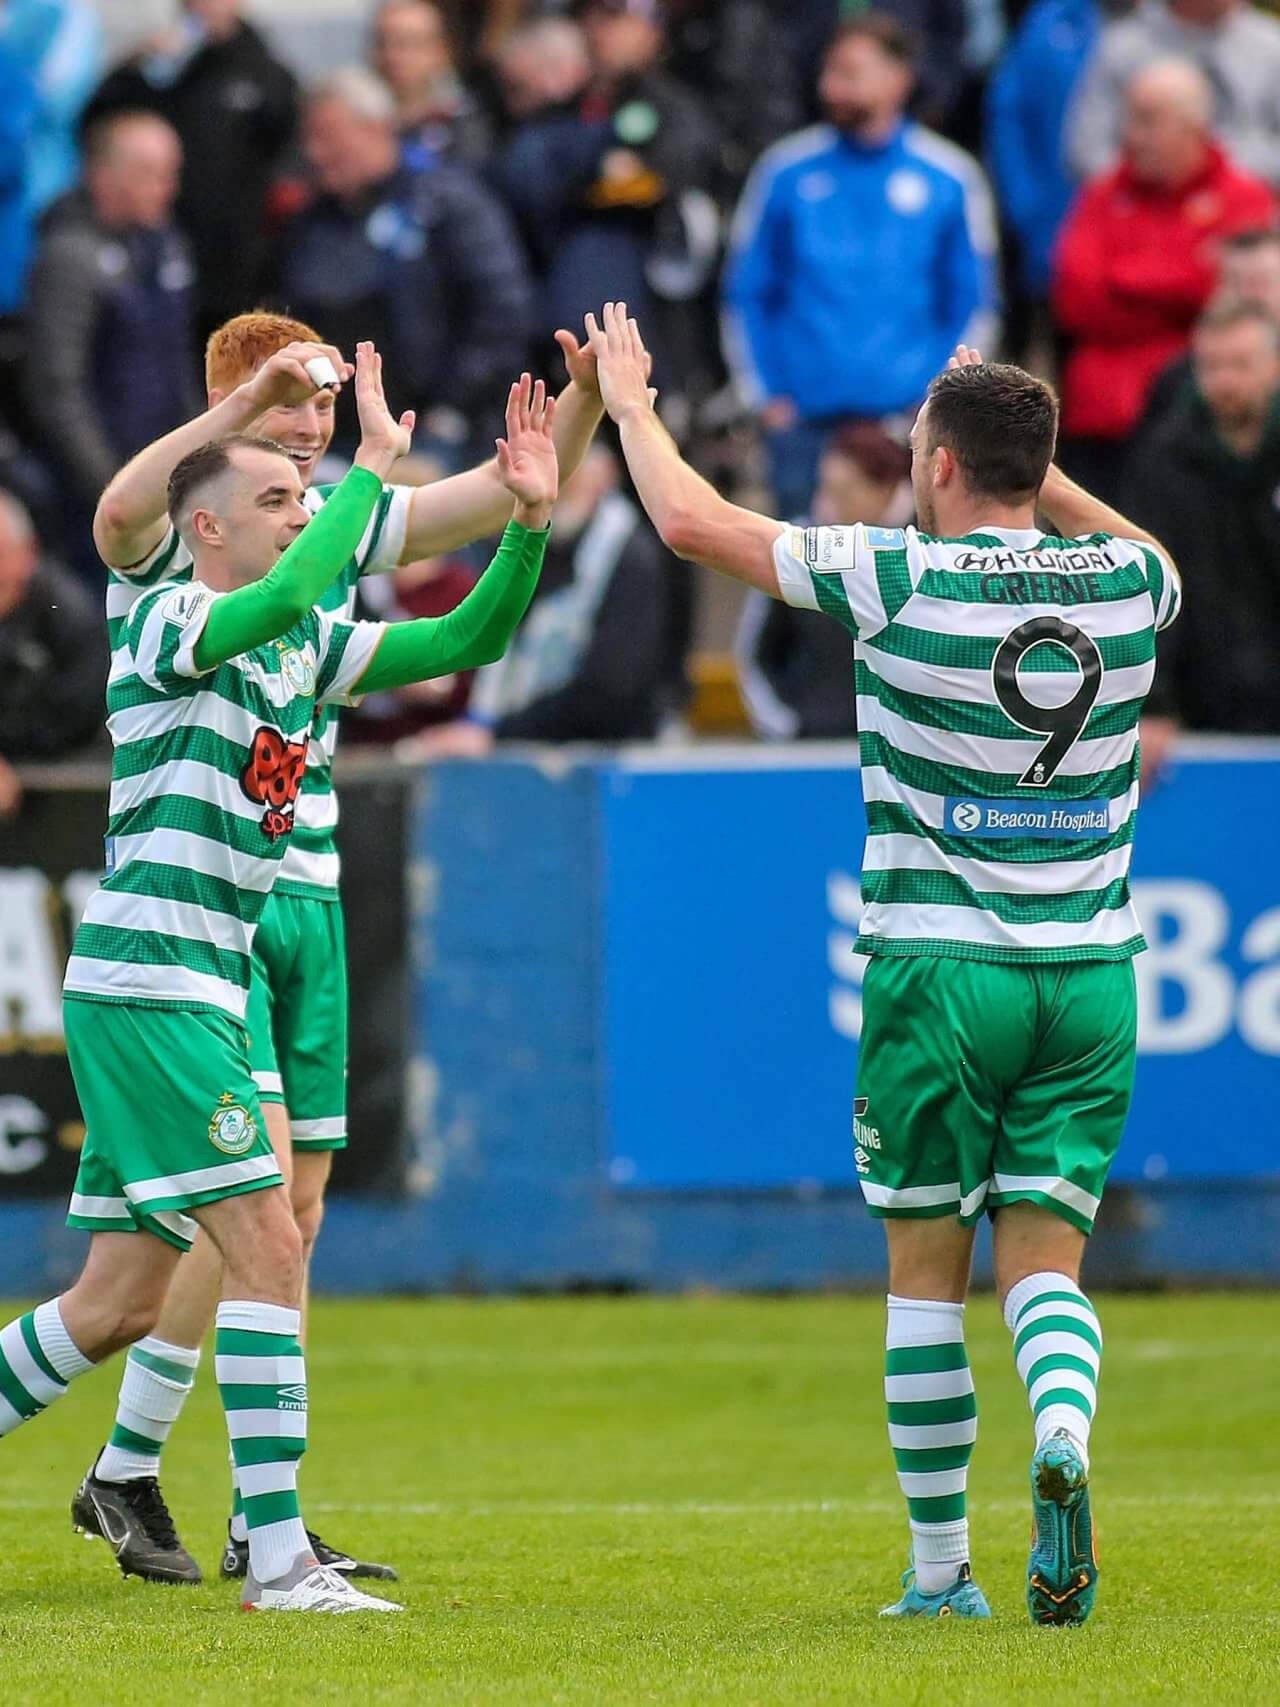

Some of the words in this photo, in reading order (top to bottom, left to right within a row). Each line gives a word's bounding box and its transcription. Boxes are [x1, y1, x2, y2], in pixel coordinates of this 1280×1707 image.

[991, 616, 1104, 788] 9
[986, 808, 1047, 829] Beacon
[1049, 808, 1108, 833] Hospital
